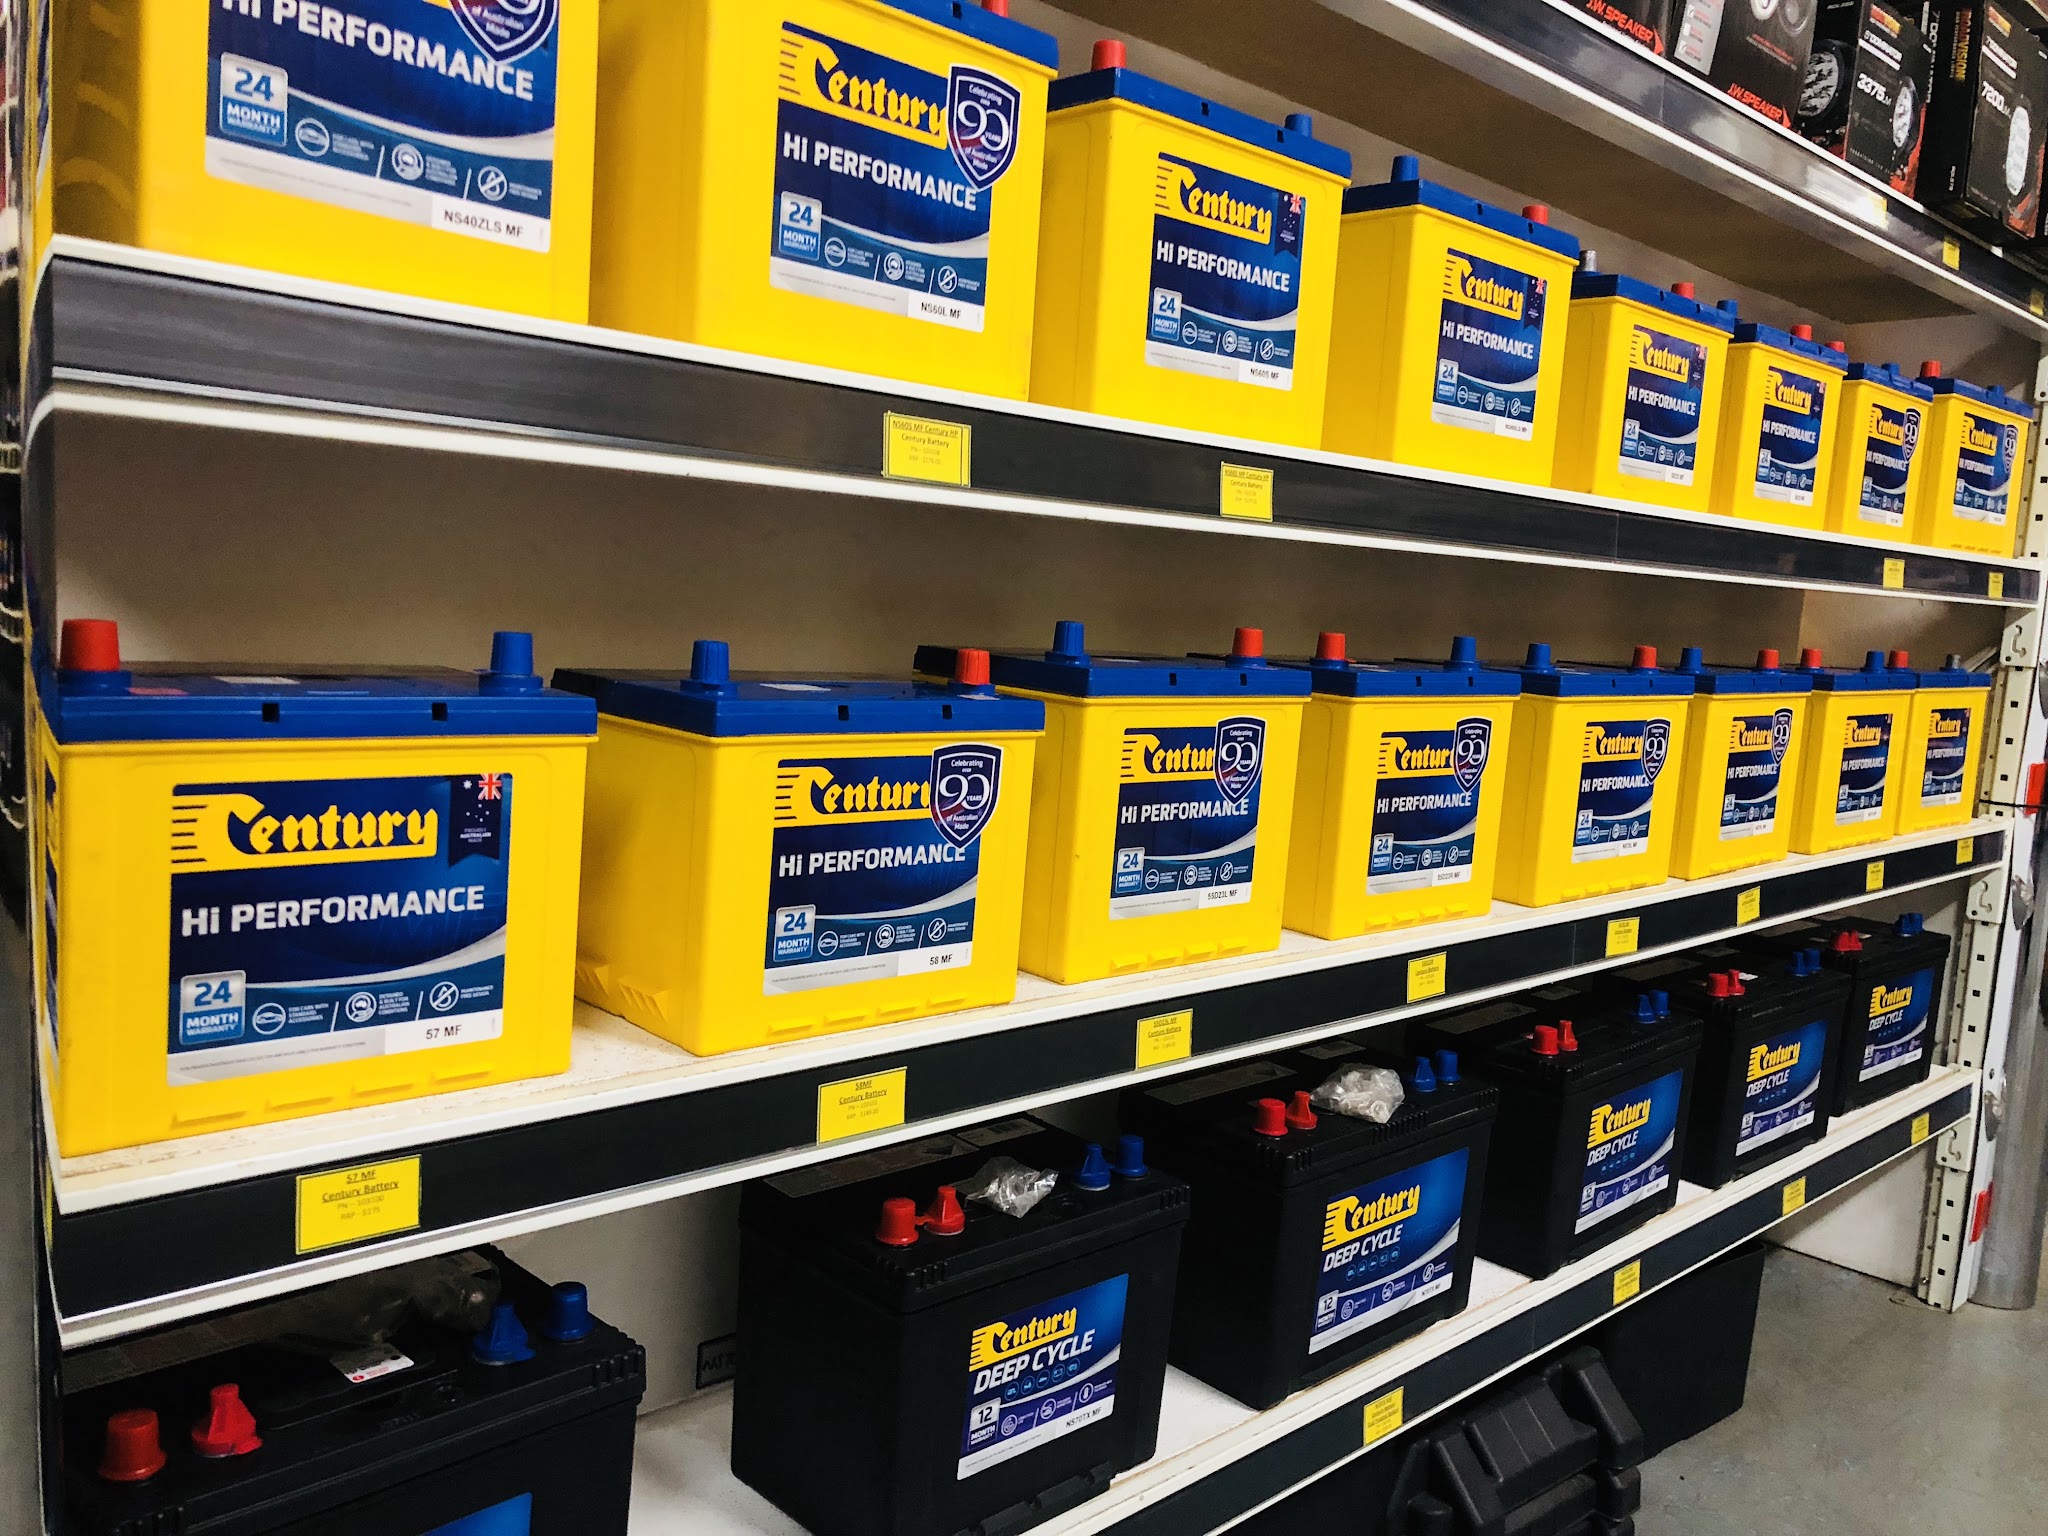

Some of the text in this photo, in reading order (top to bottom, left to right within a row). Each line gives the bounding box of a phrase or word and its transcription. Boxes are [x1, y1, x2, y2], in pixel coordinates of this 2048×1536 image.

[273, 0, 534, 101] PERFORMANCE
[234, 68, 275, 101] 24
[779, 28, 948, 150] Century
[226, 102, 281, 129] MONTH
[957, 100, 1009, 151] 90
[782, 131, 977, 212] Hi PERFORMANCE
[1154, 159, 1272, 245] Century
[444, 210, 524, 239] NS40ZLS MF
[788, 202, 814, 227] 24
[783, 229, 817, 246] MONTH
[1156, 239, 1291, 293] Hi PERFORMANCE
[1442, 253, 1525, 321] Century
[921, 302, 948, 318] NS60L
[1158, 295, 1176, 315] 24
[1154, 316, 1178, 330] MONTH
[1456, 324, 1535, 361] PERFORMANCE
[1629, 330, 1690, 383] Century
[1442, 364, 1455, 381] 24
[1638, 388, 1697, 417] PERFORMANCE
[1764, 370, 1813, 416] Century
[901, 433, 950, 449] Century Battery
[925, 424, 949, 437] Century
[1626, 423, 1637, 436] 24
[1771, 422, 1817, 445] PERFORMANCE
[1960, 416, 1998, 457] Century
[1873, 452, 1907, 473] PERFORMANCE
[1729, 720, 1772, 754] Century
[1844, 719, 1881, 749] Century
[1928, 712, 1961, 739] Century
[1458, 738, 1485, 766] 90
[1582, 726, 1643, 763] Century
[1645, 737, 1666, 760] 90
[1933, 746, 1965, 759] PERFORMANCE
[951, 759, 984, 769] Celebrating
[1119, 734, 1214, 784] Centur
[1220, 742, 1258, 773] 90
[1849, 757, 1885, 771] PERFORMANCE
[1735, 764, 1778, 778] PERFORMANCE
[938, 773, 992, 811] 90
[1592, 774, 1650, 792] PERFORMANCE
[1121, 798, 1250, 824] Hi PERFORMANCE
[1376, 792, 1472, 814] Hi PERFORMANCE
[953, 813, 979, 821] Australian
[954, 822, 970, 831] Made
[1580, 814, 1590, 825] 24
[171, 793, 438, 874] Century
[1376, 838, 1389, 852] 24
[779, 843, 967, 878] Hi PERFORMANCE
[1122, 852, 1139, 869] 24
[1118, 872, 1140, 883] MONTH
[1229, 888, 1239, 897] MF
[182, 885, 485, 937] Hi PERFORMANCE
[783, 912, 808, 933] 24
[777, 937, 810, 951] MONTH
[778, 945, 809, 956] WARRANTY
[930, 953, 953, 966] 58 MF
[193, 979, 232, 1007] 24
[1869, 985, 1913, 1018] Century
[185, 1011, 239, 1030] MONTH
[185, 1022, 238, 1037] WARRANTY
[425, 1024, 463, 1040] 57 MF
[1868, 1009, 1904, 1032] DEEP CYCLE
[1746, 1041, 1801, 1083] Century
[1746, 1068, 1791, 1098] DEEP CYCLE
[839, 1089, 887, 1106] Century Battery
[1587, 1098, 1651, 1150] Century
[1587, 1130, 1639, 1168] DEEP CYCLE
[346, 1169, 377, 1185] 57 MF
[322, 1181, 399, 1203] Century Battery
[1584, 1187, 1593, 1199] 12
[1322, 1184, 1421, 1251] Century
[1323, 1223, 1404, 1274] DEEP CYCLE
[1323, 1296, 1333, 1312] 12
[969, 1307, 1078, 1372] Century
[973, 1328, 1096, 1396] DEEP CYCLE
[978, 1406, 992, 1424] 12
[970, 1424, 996, 1442] MONTH
